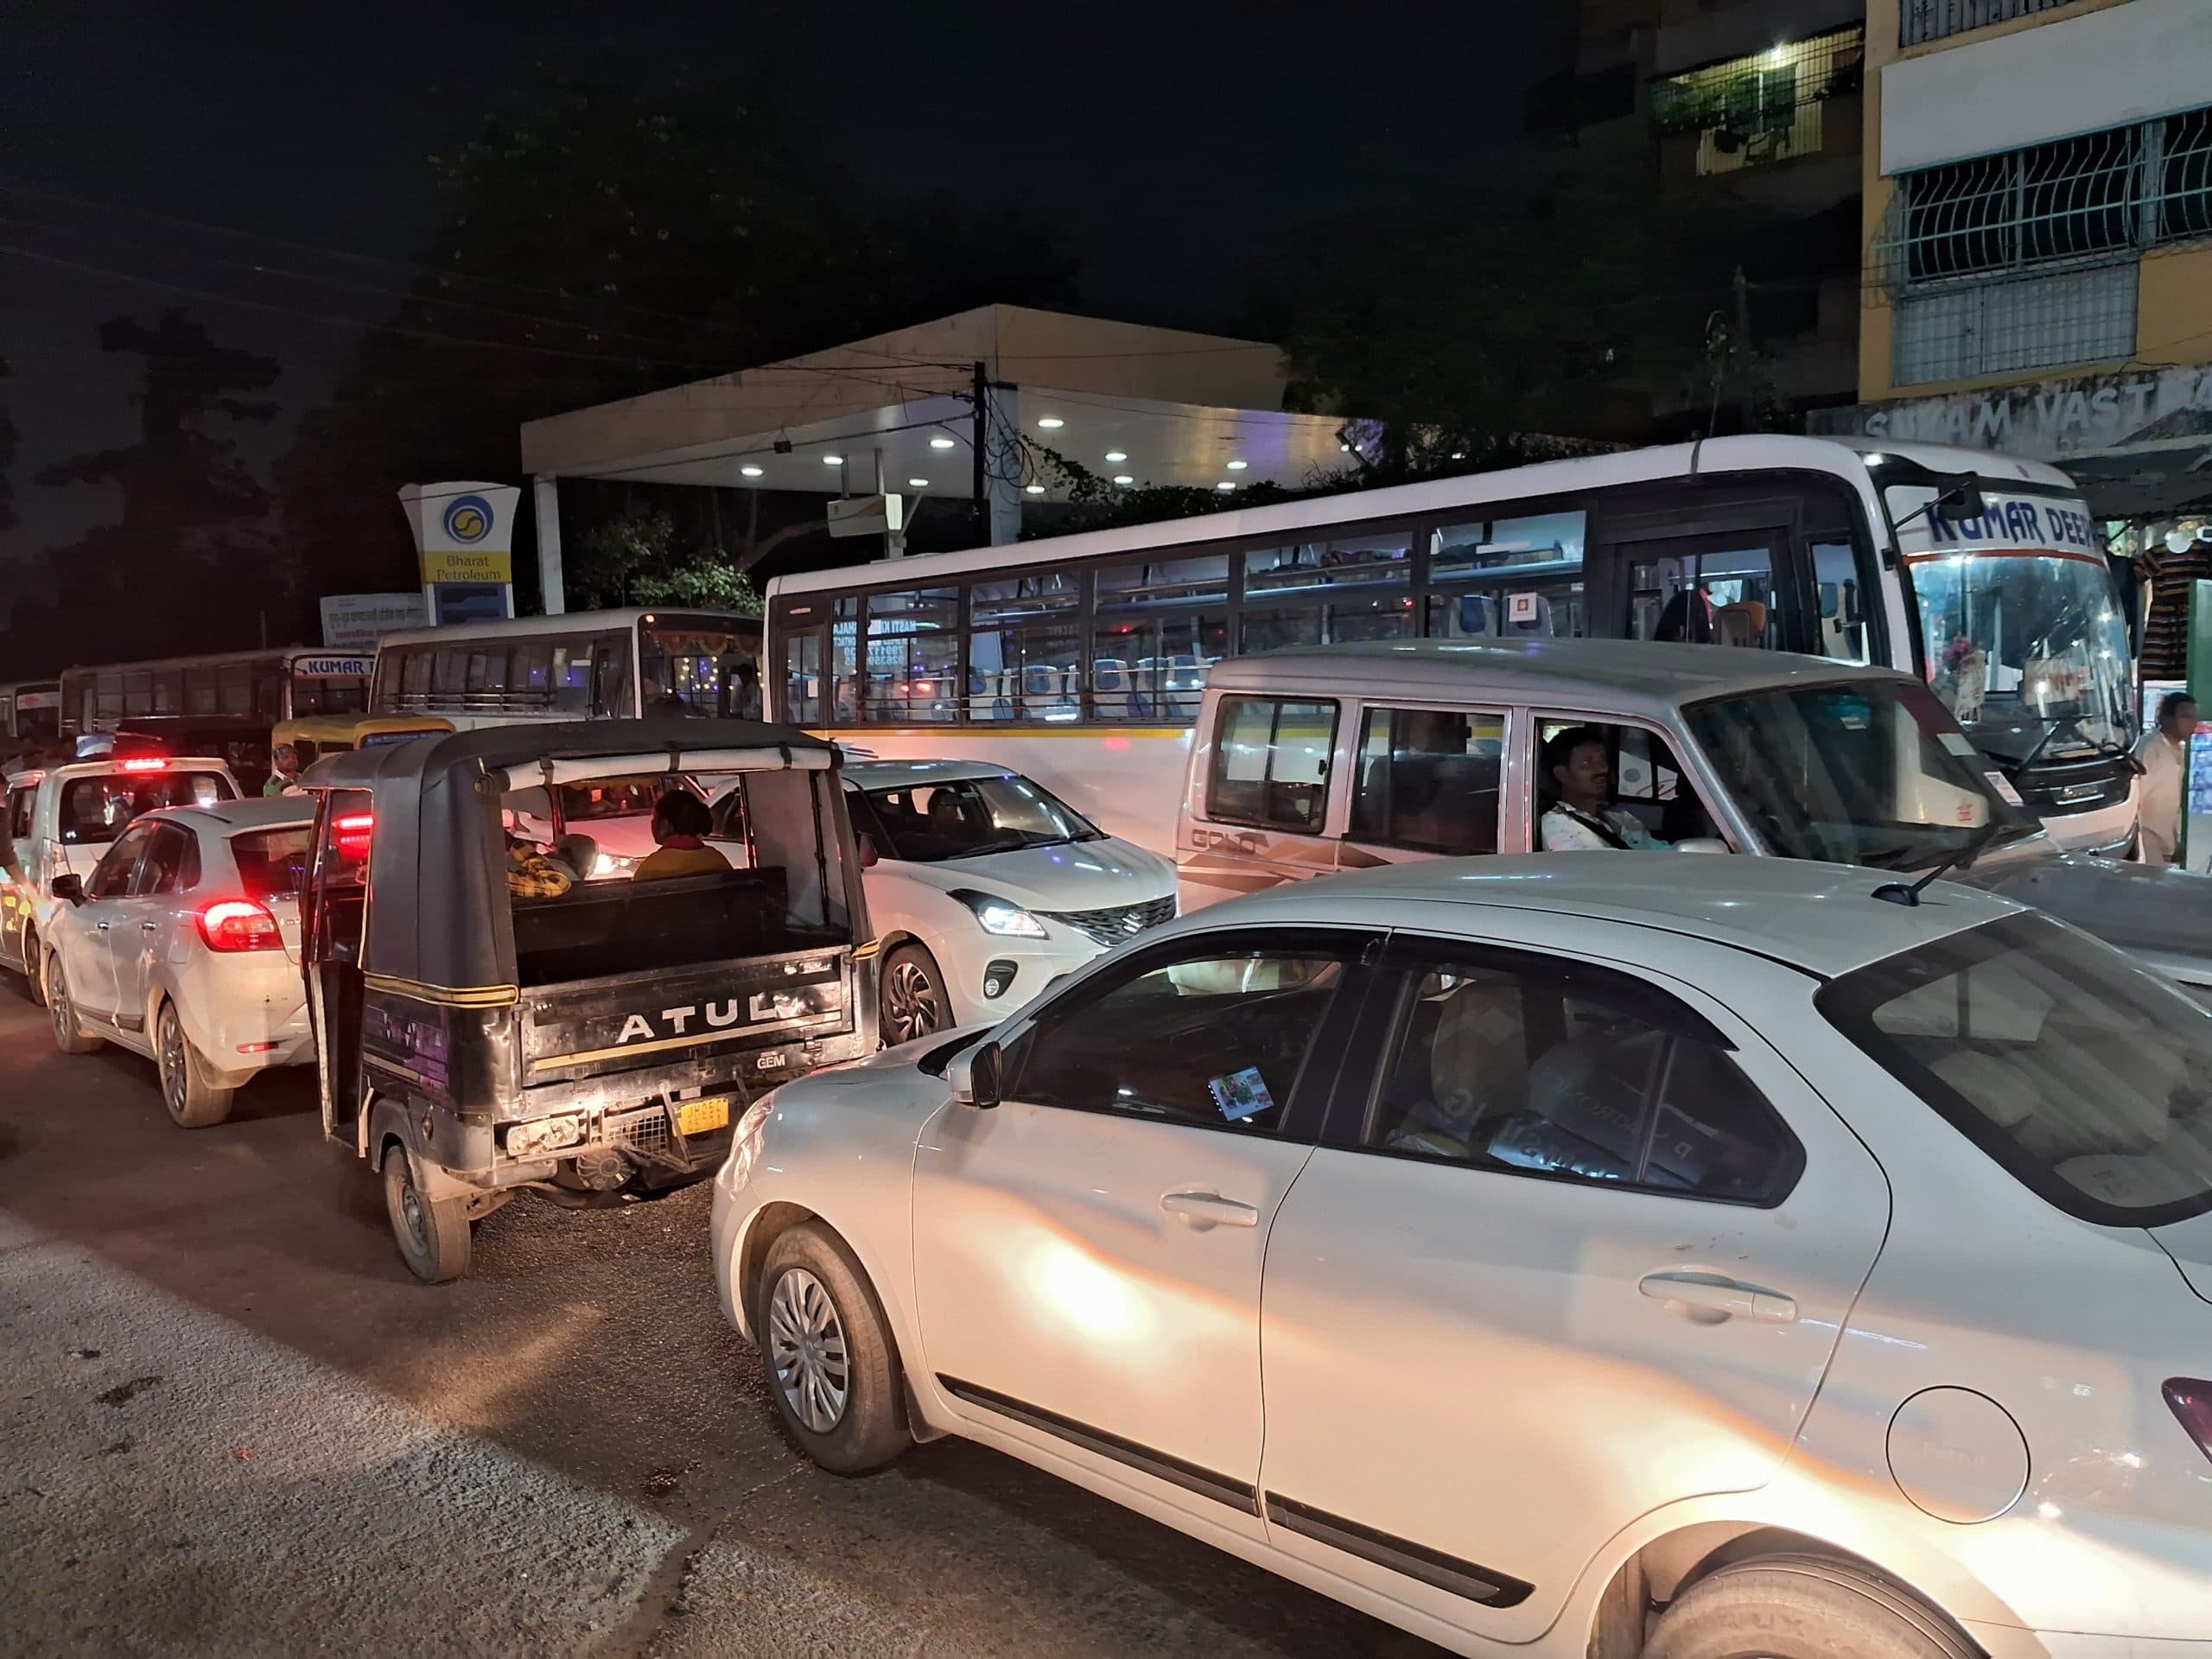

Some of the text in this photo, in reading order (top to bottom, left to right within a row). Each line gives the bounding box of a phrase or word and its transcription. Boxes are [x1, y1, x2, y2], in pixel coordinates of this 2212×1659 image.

[1924, 501, 2046, 545] KUMAR
[447, 555, 489, 568] Bharat
[437, 569, 501, 582] Petroleum
[308, 660, 364, 673] KUMAR
[615, 995, 777, 1045] ATUL
[757, 1054, 785, 1070] GEM
